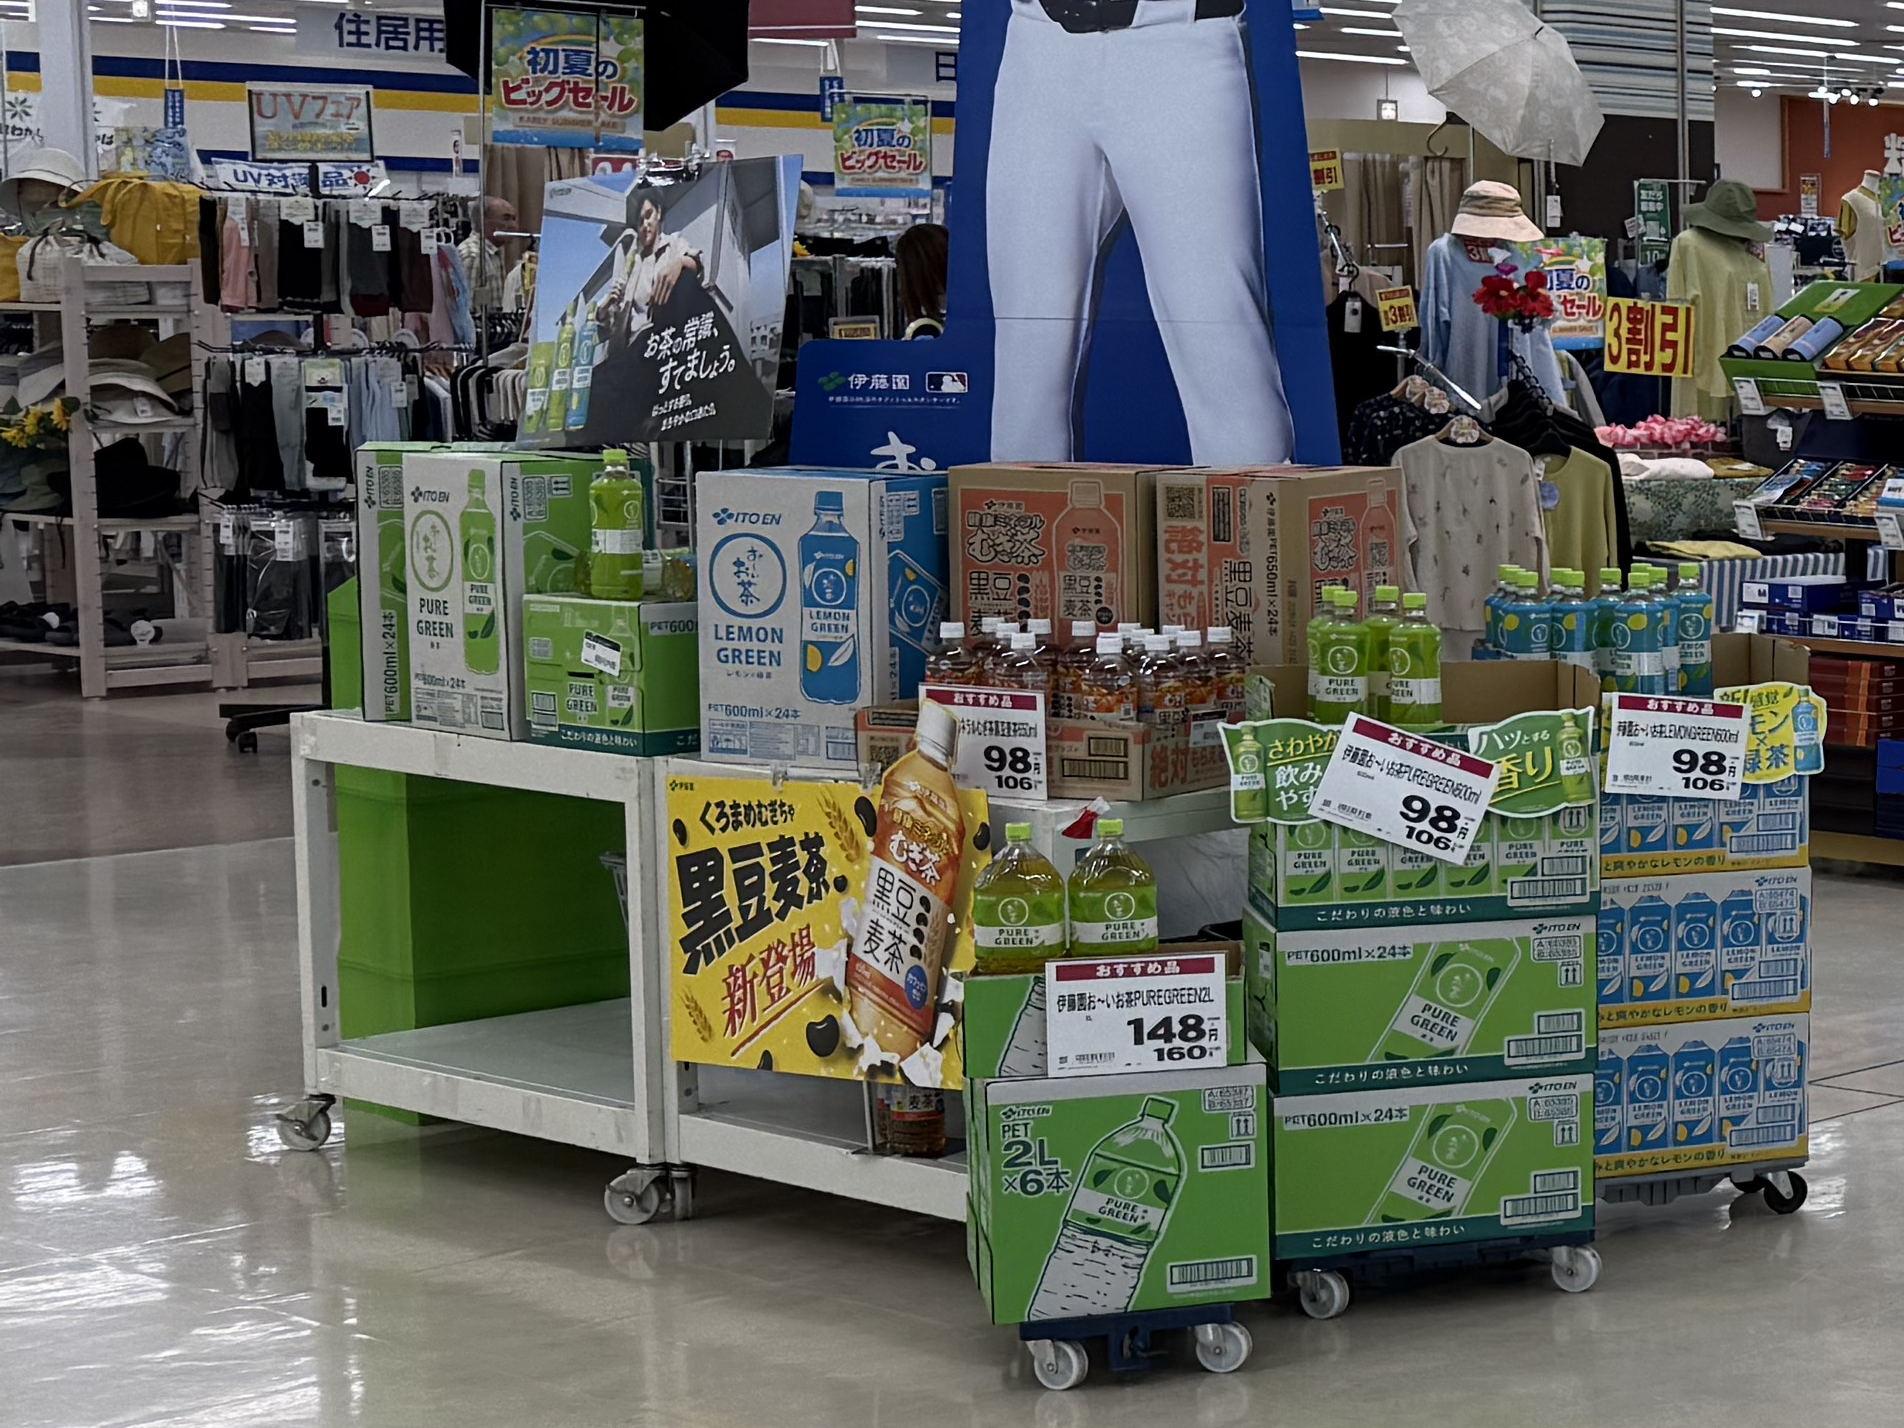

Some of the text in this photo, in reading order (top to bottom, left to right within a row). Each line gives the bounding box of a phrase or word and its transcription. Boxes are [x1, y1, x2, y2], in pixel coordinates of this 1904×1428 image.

[527, 47, 618, 80] 初夏の
[255, 92, 362, 122] UVフェア
[502, 79, 638, 115] ビッグセール
[854, 128, 914, 150] 初夏の
[839, 148, 925, 173] ビッグセール
[1608, 301, 1692, 375] 3割引
[658, 345, 735, 394] すてましょう。
[848, 374, 909, 389] 伊藤園
[969, 572, 1012, 601] 黒豆
[1063, 575, 1092, 596] 黒豆
[419, 598, 449, 616] PURE
[809, 610, 851, 622] LEMON
[1064, 600, 1093, 617] 麦茶
[416, 622, 454, 639] GREEN
[714, 624, 784, 645] LEMON
[716, 647, 782, 667] GREEN
[569, 683, 594, 698] PURE
[953, 692, 1013, 708] おすすめ品
[1647, 699, 1714, 715] おすすめ品
[1750, 711, 1790, 736] モン
[983, 745, 1033, 774] 98
[1388, 733, 1462, 766] おすすめ品
[1275, 762, 1322, 788] 飲み
[1495, 746, 1554, 792] 香り
[1673, 749, 1726, 776] 98
[995, 775, 1033, 790] 106
[1682, 777, 1724, 791] 106
[700, 799, 795, 835] くろまめむぎちゃ
[1400, 794, 1461, 835] 98
[1405, 824, 1452, 852] 106
[889, 830, 942, 886] むぎ茶
[676, 831, 831, 975] 黒豆麦茶
[872, 867, 916, 927] 黒豆
[863, 919, 906, 975] 麦茶
[1096, 960, 1180, 977] おすすめ品
[722, 924, 817, 1039] 新登場
[1410, 1014, 1458, 1042] GREEN
[1421, 1003, 1461, 1028] PURE
[1127, 1014, 1206, 1045] 148
[1154, 1045, 1207, 1061] 160
[1002, 1123, 1030, 1139] PET
[1002, 1140, 1059, 1169] 2L
[1003, 1169, 1070, 1196] ×6本
[1417, 1164, 1458, 1188] PURE
[1407, 1175, 1455, 1203] GREEN
[1098, 1206, 1138, 1223] GREEN
[1106, 1197, 1138, 1214] PURE
[1312, 1224, 1465, 1249] こだわりの液色と味わい
